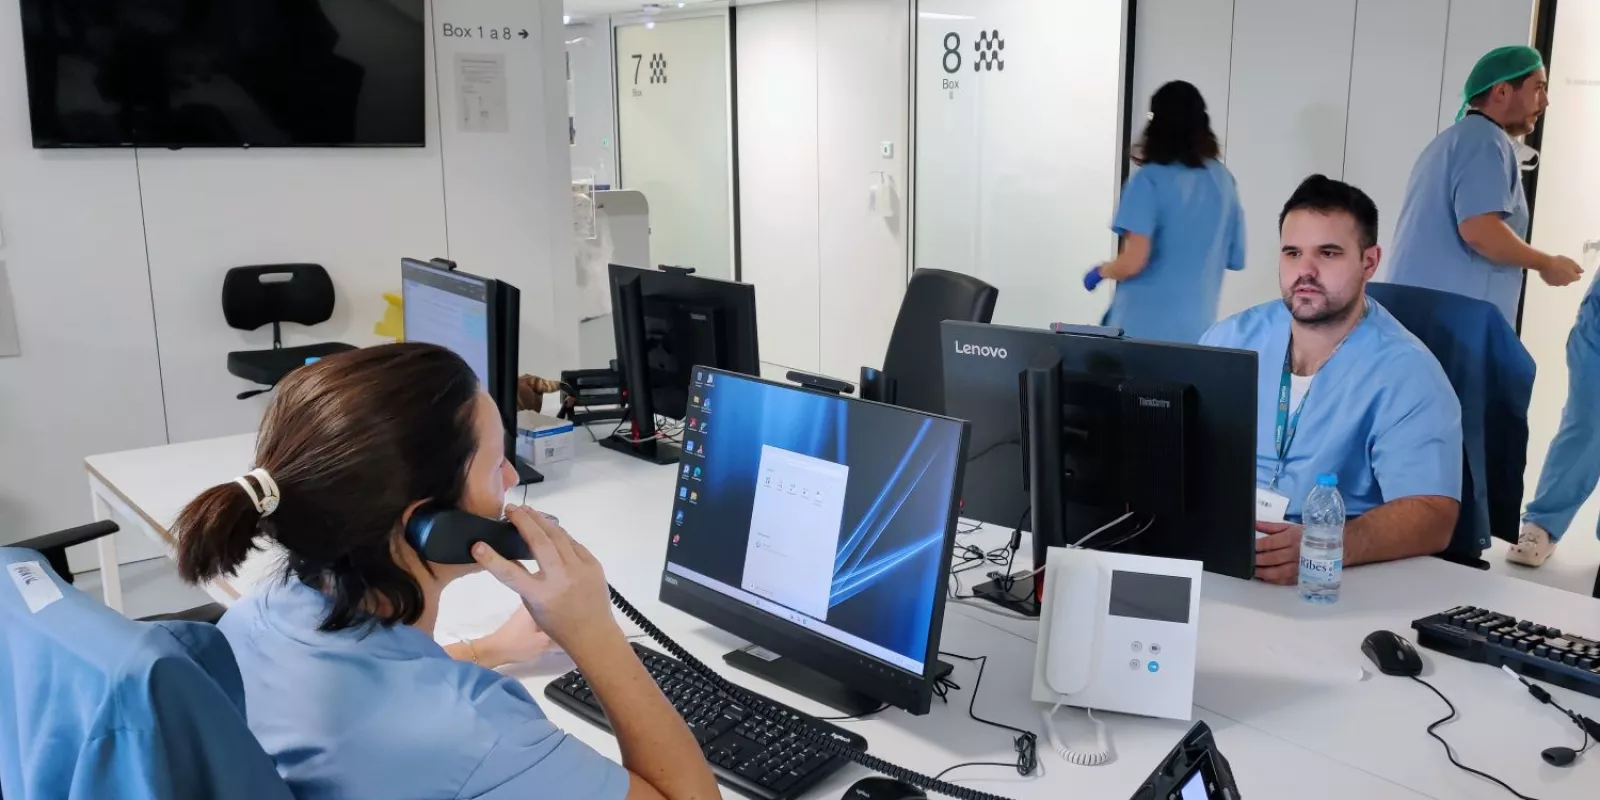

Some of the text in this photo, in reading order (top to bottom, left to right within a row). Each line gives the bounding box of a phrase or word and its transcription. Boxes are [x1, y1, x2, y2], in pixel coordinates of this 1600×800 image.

[443, 22, 512, 40] Box 1 a 8
[942, 31, 961, 74] 8
[631, 54, 642, 85] 7
[942, 78, 959, 90] Box
[955, 339, 1008, 359] Lenovo
[1300, 555, 1327, 572] Ribes
